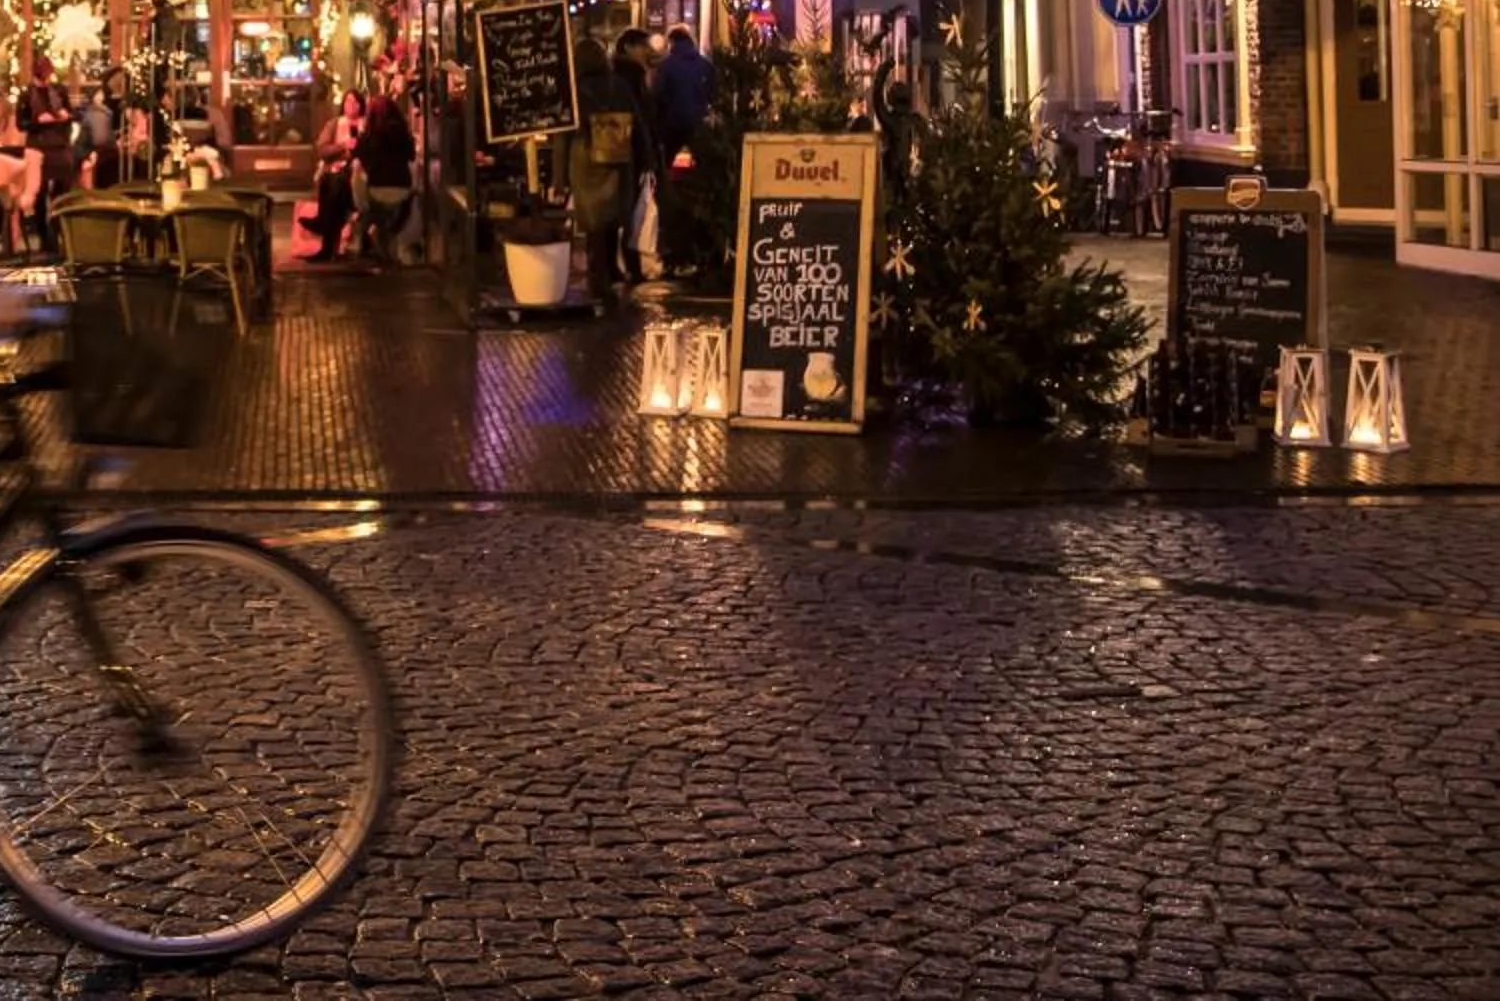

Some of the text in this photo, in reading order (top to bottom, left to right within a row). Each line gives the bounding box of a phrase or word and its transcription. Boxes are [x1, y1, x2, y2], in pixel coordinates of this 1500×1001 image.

[774, 158, 840, 182] Duvel
[779, 221, 795, 240] &
[753, 262, 842, 284] VAN 100
[756, 282, 849, 303] SOORTEN
[769, 323, 839, 348] BEIER
